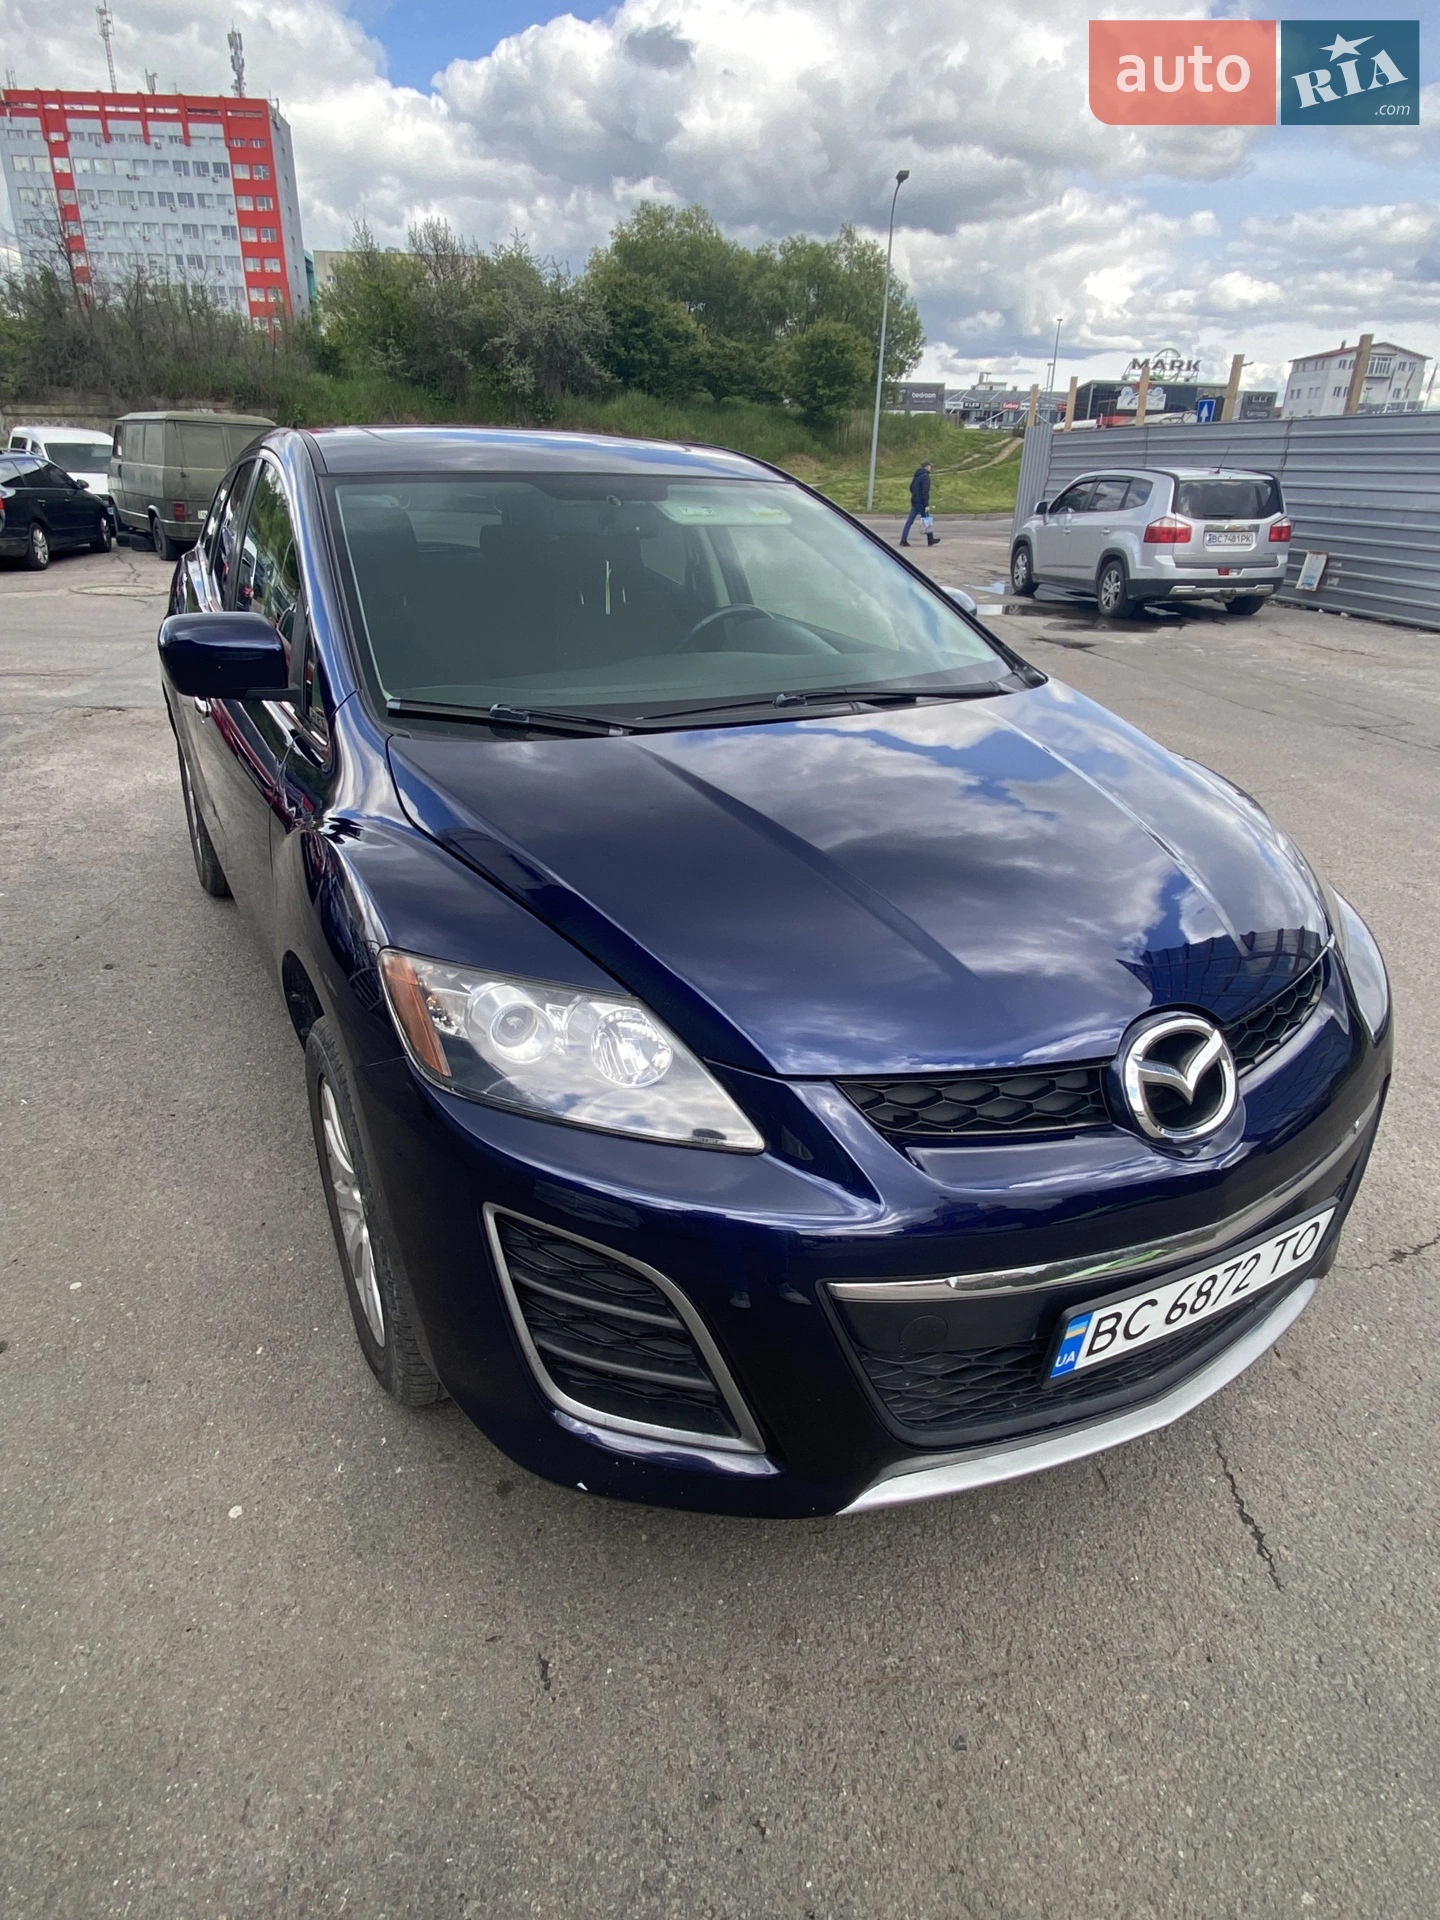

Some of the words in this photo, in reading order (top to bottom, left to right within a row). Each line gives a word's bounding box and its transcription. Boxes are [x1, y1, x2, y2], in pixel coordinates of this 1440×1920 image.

[1131, 358, 1202, 372] MARK
[911, 391, 937, 399] bedroom
[1086, 1298, 1158, 1358] BC
[1165, 1252, 1261, 1325] 6872
[1270, 1221, 1320, 1274] TO
[1055, 1350, 1076, 1368] UA
